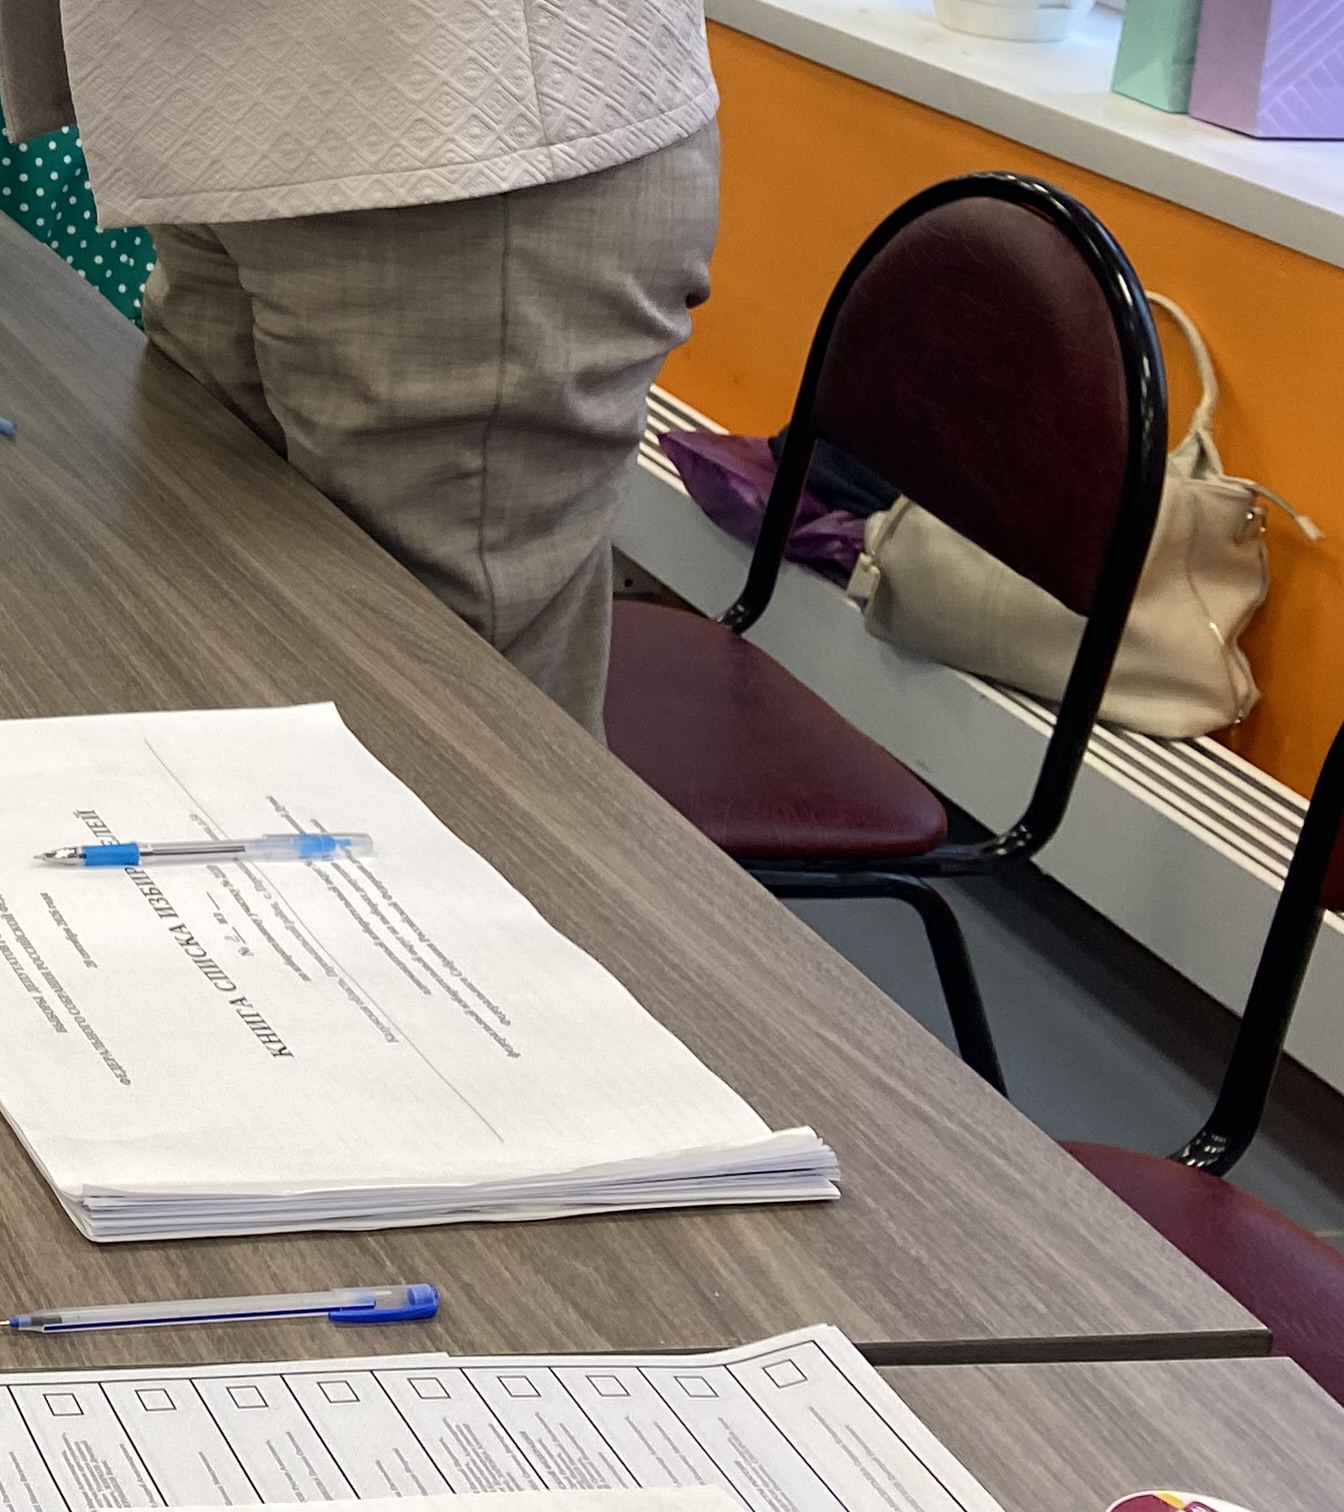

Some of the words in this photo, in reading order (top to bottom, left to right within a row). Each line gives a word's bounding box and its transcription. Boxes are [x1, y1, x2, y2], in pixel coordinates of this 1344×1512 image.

[75, 810, 177, 918] ИЗБИРЕЛЕЙ
[168, 923, 237, 992] СПИСКА
[229, 996, 294, 1057] КНИГА
